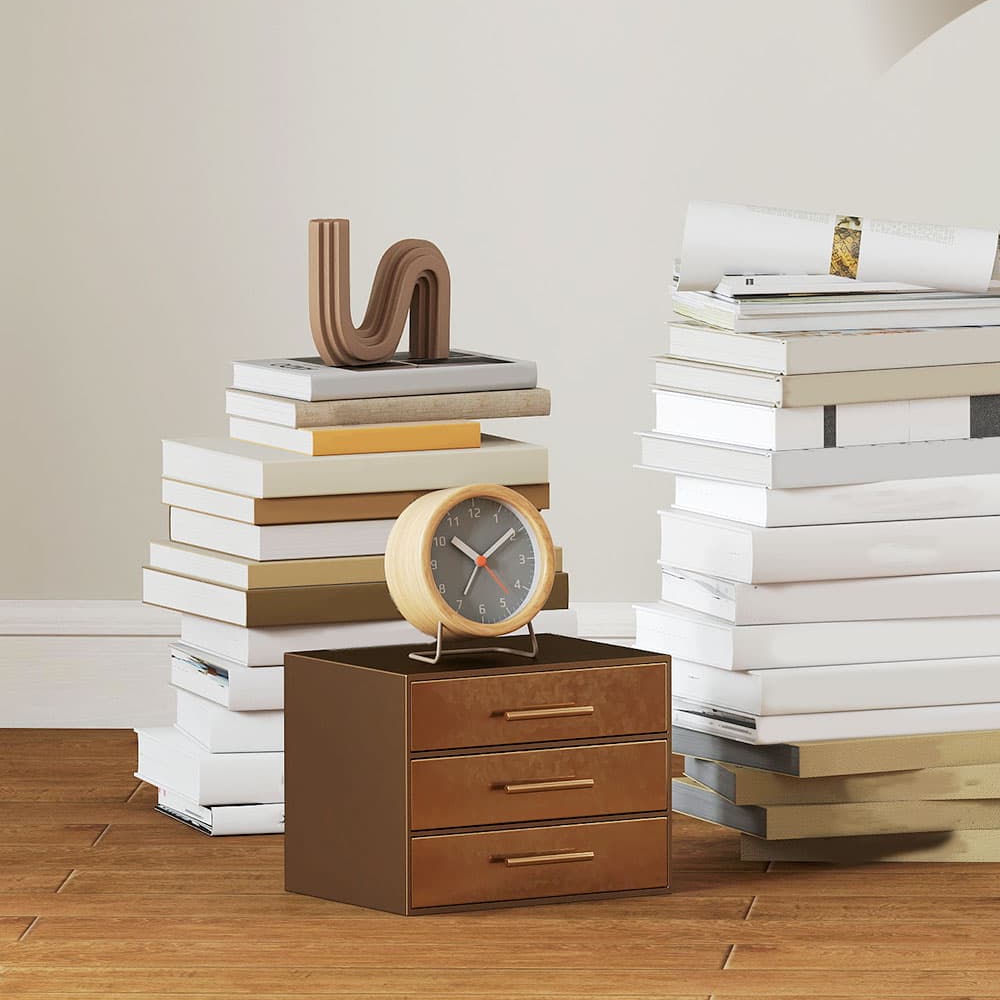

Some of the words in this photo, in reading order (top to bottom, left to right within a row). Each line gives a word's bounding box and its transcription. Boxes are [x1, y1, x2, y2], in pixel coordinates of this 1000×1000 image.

[468, 508, 481, 518] 12
[447, 517, 459, 527] 11
[493, 514, 499, 523] 1
[433, 536, 446, 546] 10
[430, 560, 437, 570] 9
[519, 555, 525, 565] 3
[439, 584, 445, 593] 8
[514, 579, 521, 589] 4
[456, 600, 463, 609] 7
[500, 598, 506, 608] 5
[479, 604, 486, 614] 6
